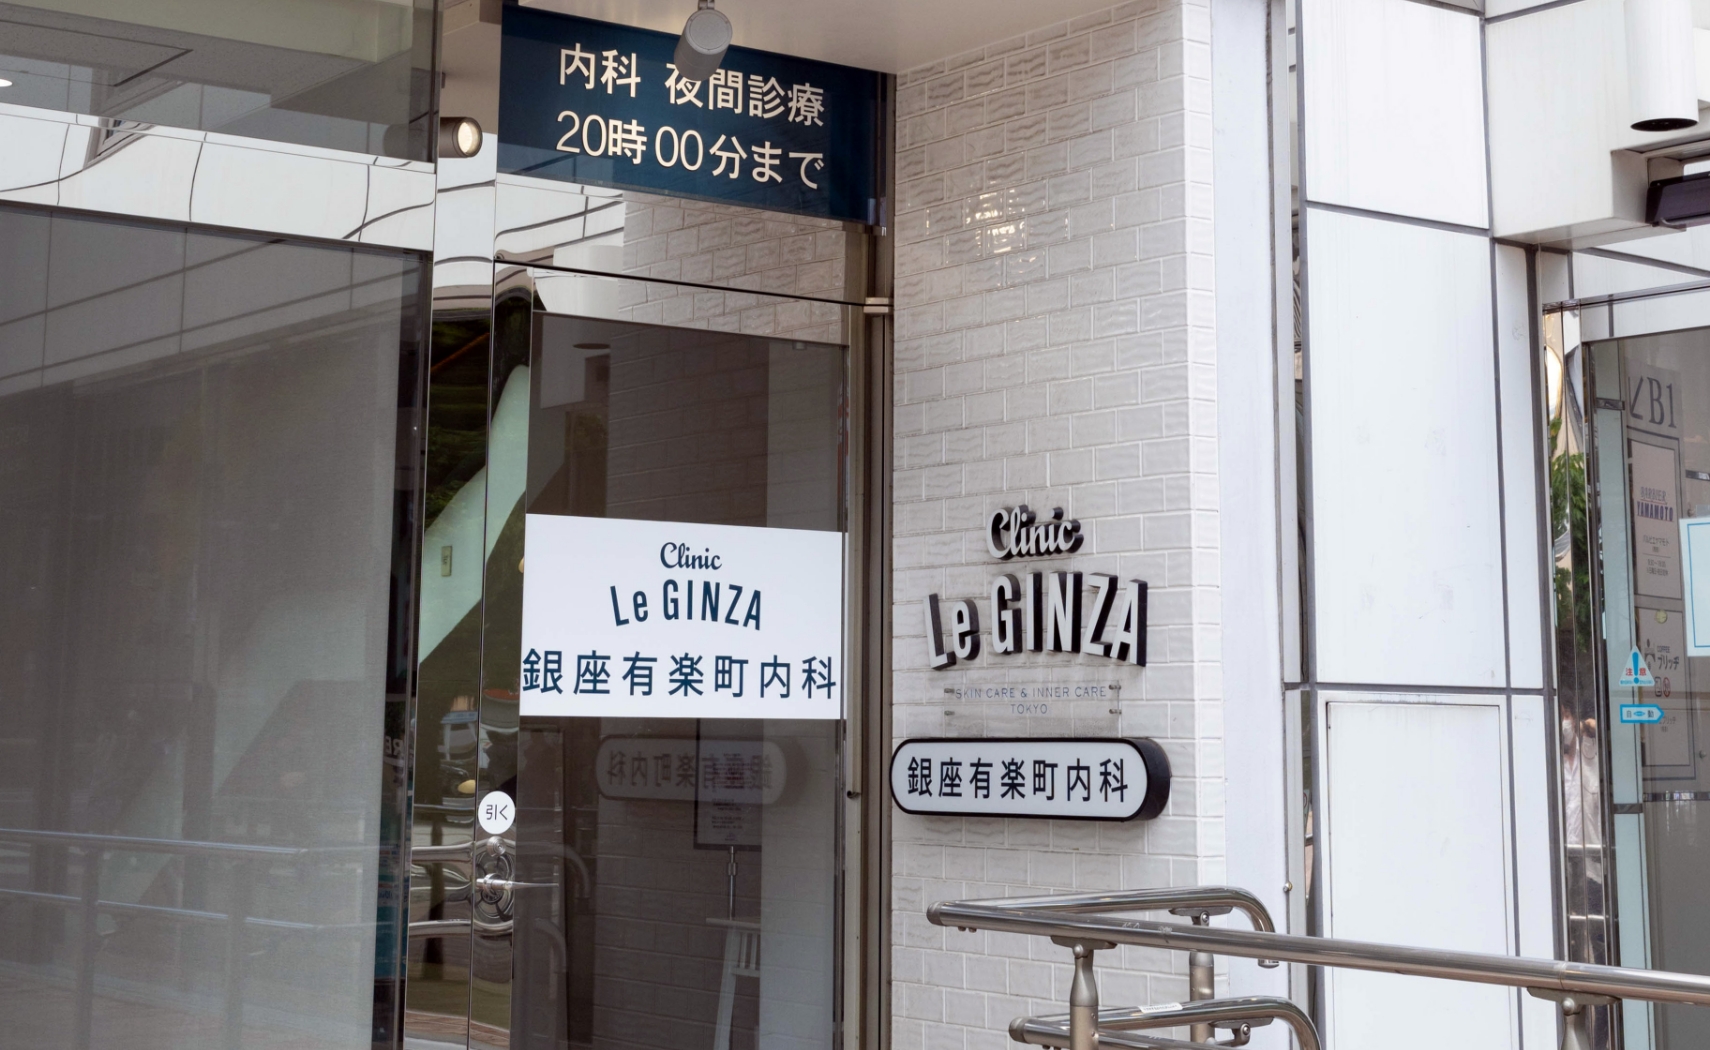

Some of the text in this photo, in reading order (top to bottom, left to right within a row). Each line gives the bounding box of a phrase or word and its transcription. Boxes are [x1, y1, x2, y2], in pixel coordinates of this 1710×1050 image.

[560, 43, 825, 127] 内科 夜間診療
[556, 110, 825, 190] 20時00分まで
[985, 504, 1084, 560] Clinic
[1637, 501, 1674, 522] YAMAMOTO
[660, 542, 722, 570] Clinic
[610, 579, 761, 631] Le GINZA
[925, 571, 1148, 671] Le GINZA
[522, 648, 836, 699] 銀座有楽町内科
[955, 686, 1107, 699] SKIN CARE & INNER CARE
[1011, 703, 1048, 715] TOKYO
[907, 756, 1128, 803] 銀座有楽町内科
[486, 804, 508, 821] 引く
